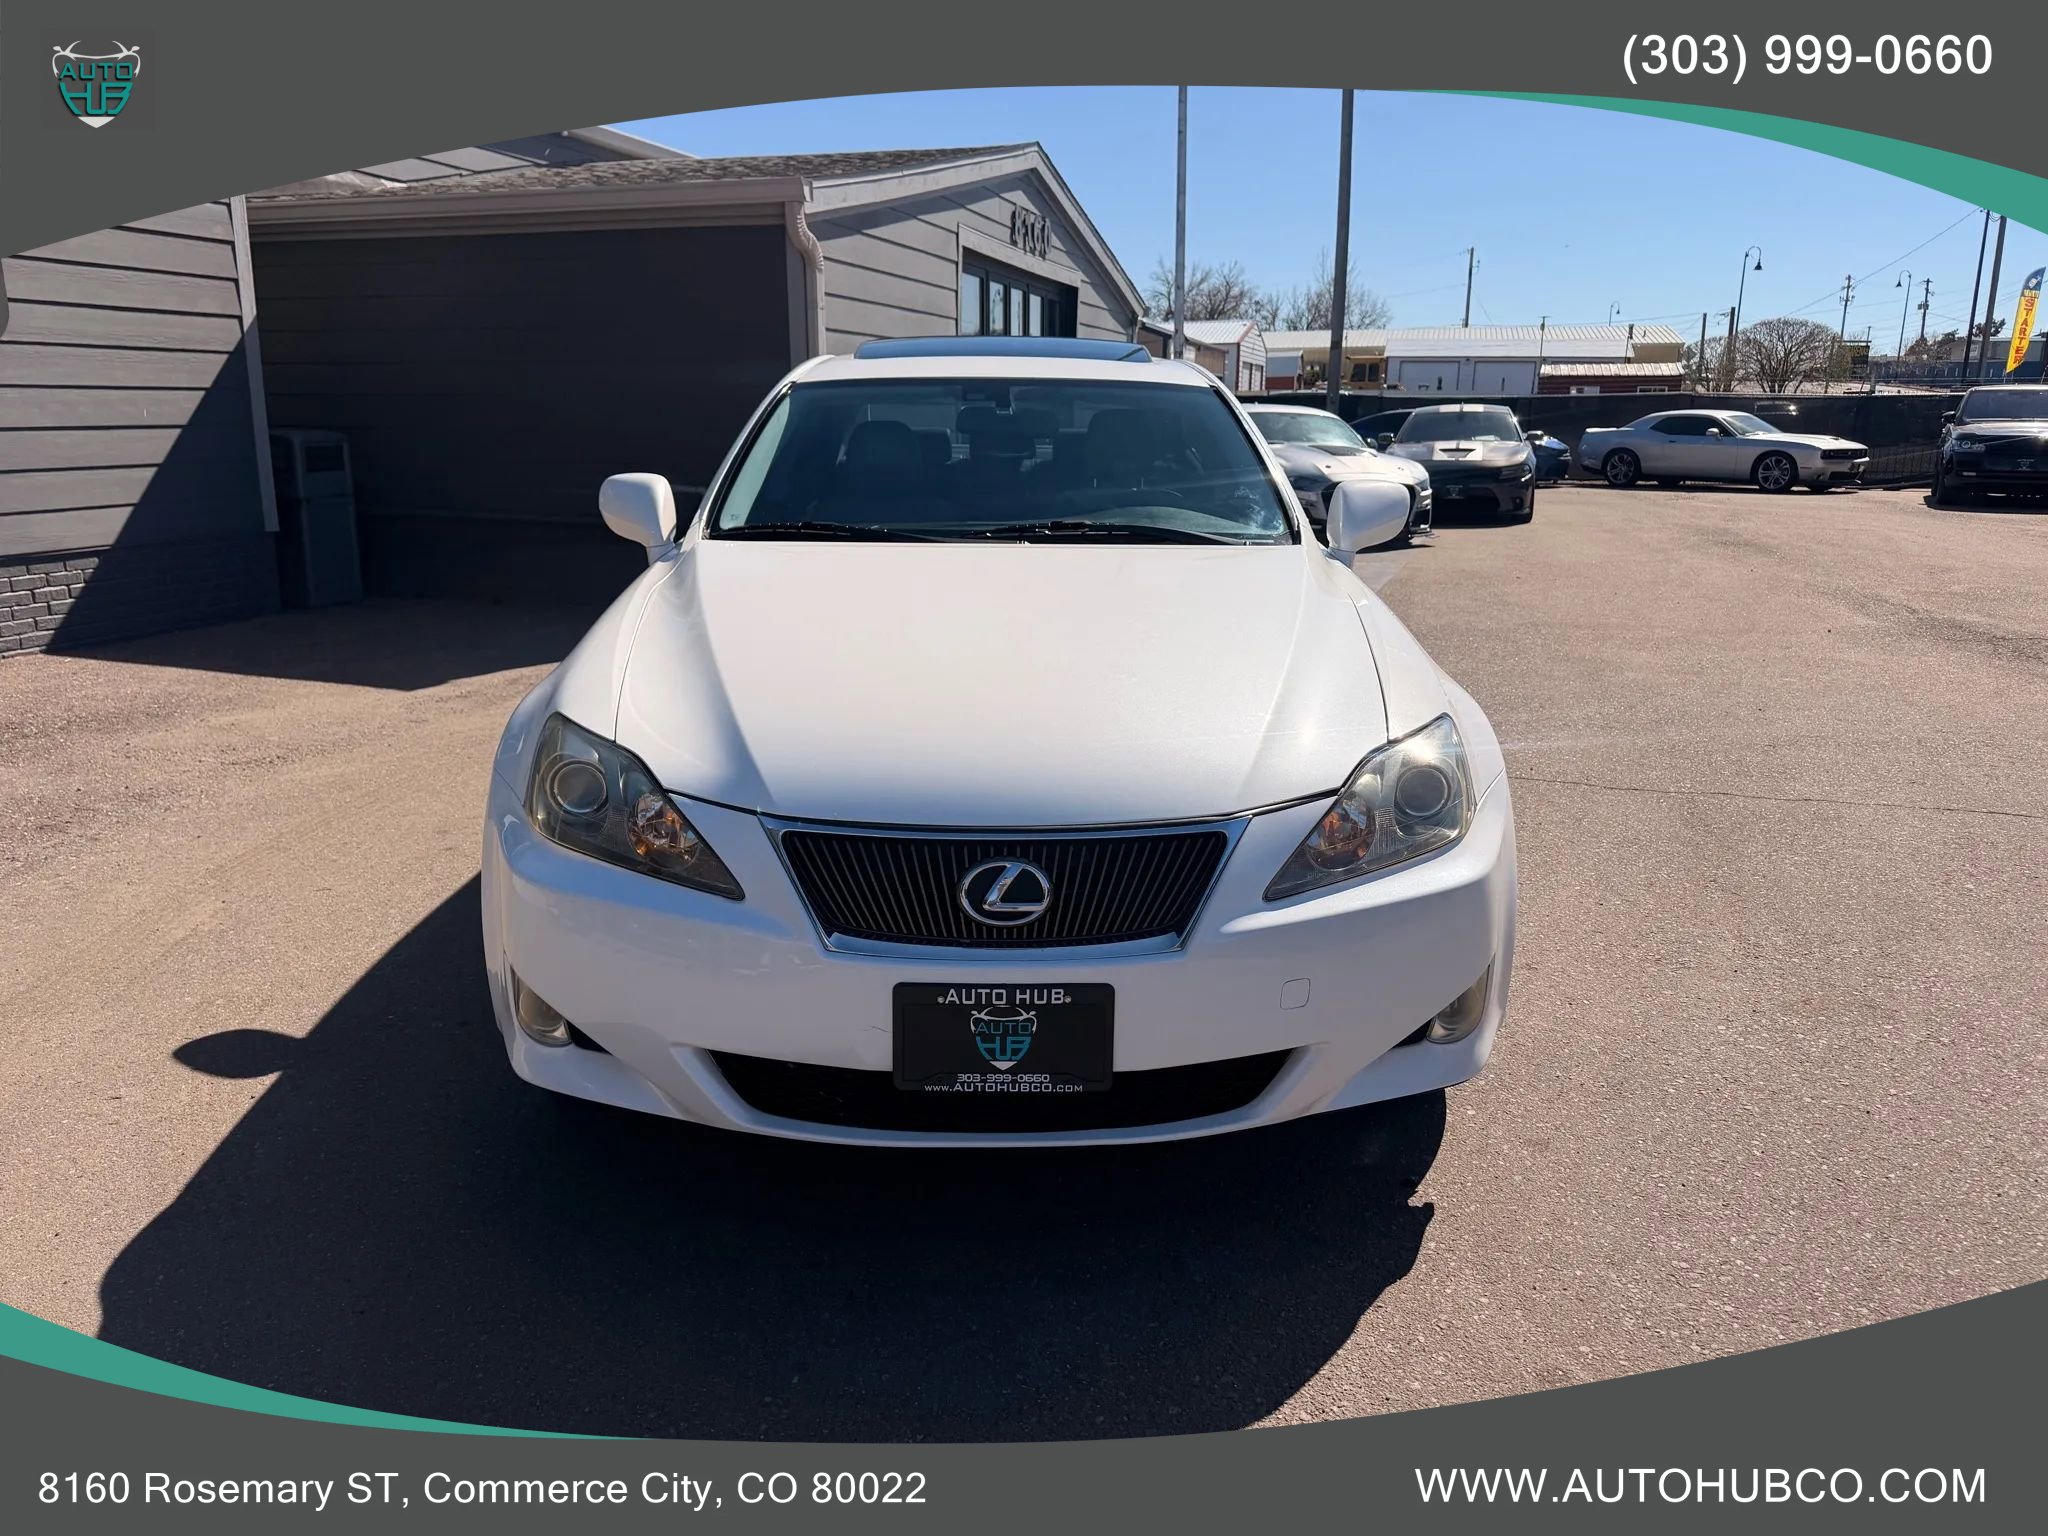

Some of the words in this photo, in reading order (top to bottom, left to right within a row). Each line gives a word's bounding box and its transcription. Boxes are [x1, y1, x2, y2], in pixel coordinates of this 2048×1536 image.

[2013, 297, 2036, 364] STARTER
[945, 988, 1007, 1005] AUTO
[1016, 988, 1065, 1005] HUB
[975, 1022, 1032, 1034] AUTO
[975, 1036, 1032, 1061] HUB
[957, 1073, 1050, 1083] 303-999-0660
